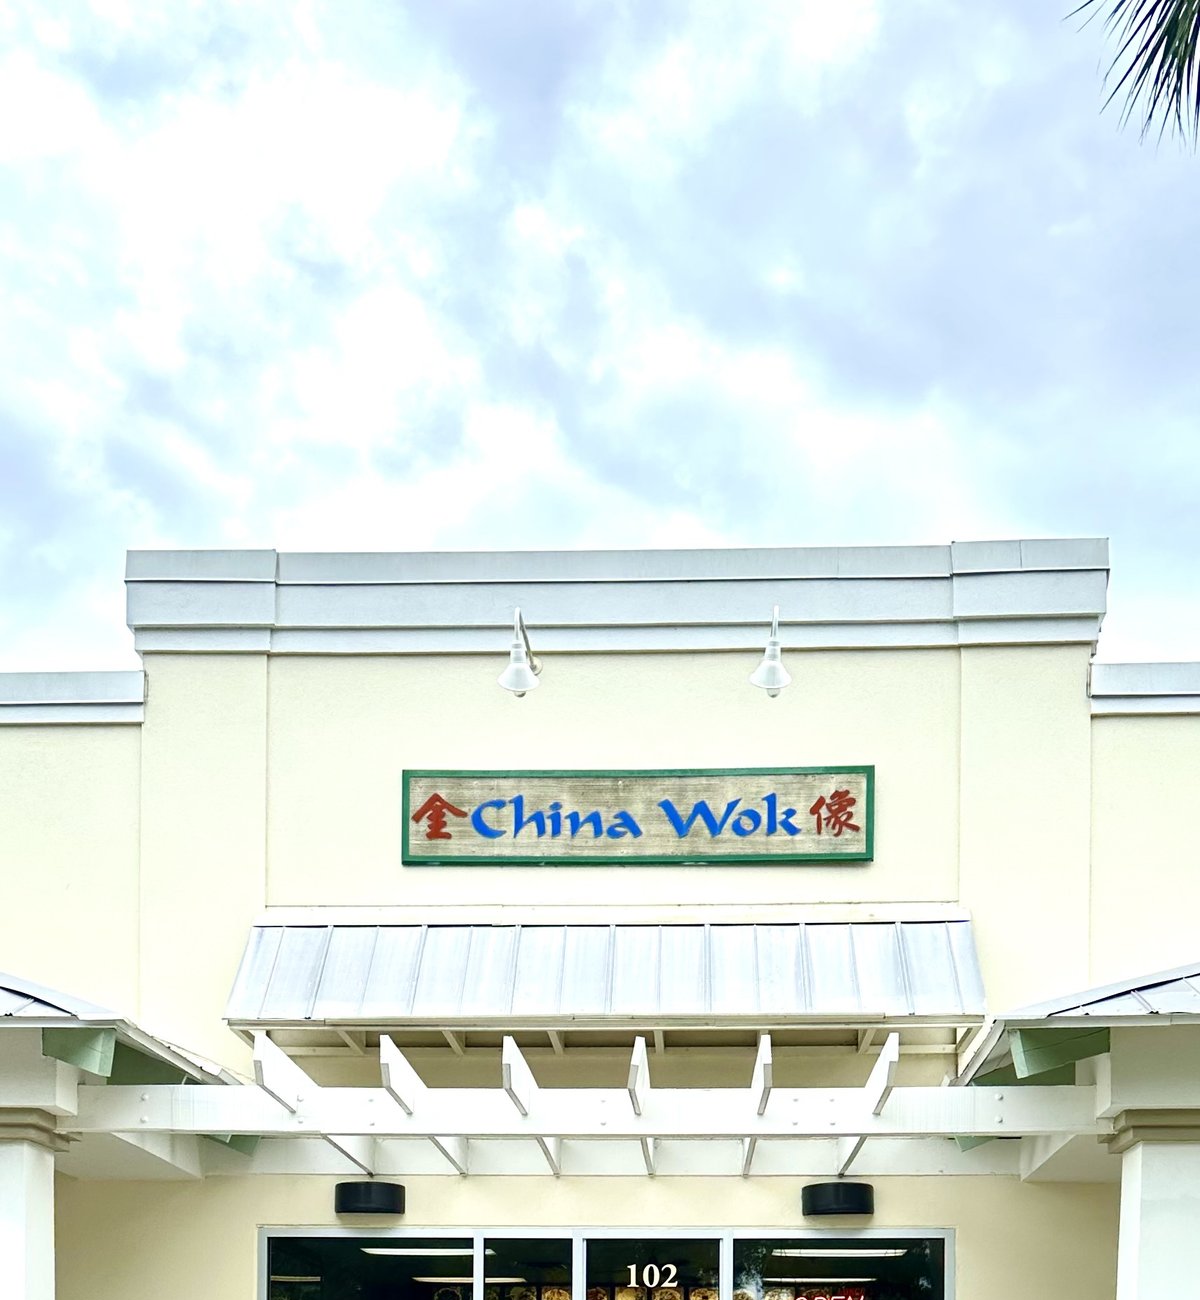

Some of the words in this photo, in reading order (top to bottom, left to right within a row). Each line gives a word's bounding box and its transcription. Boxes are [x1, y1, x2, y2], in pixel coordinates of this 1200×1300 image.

[470, 794, 643, 840] China
[657, 792, 801, 838] Wok
[626, 1263, 678, 1288] 102
